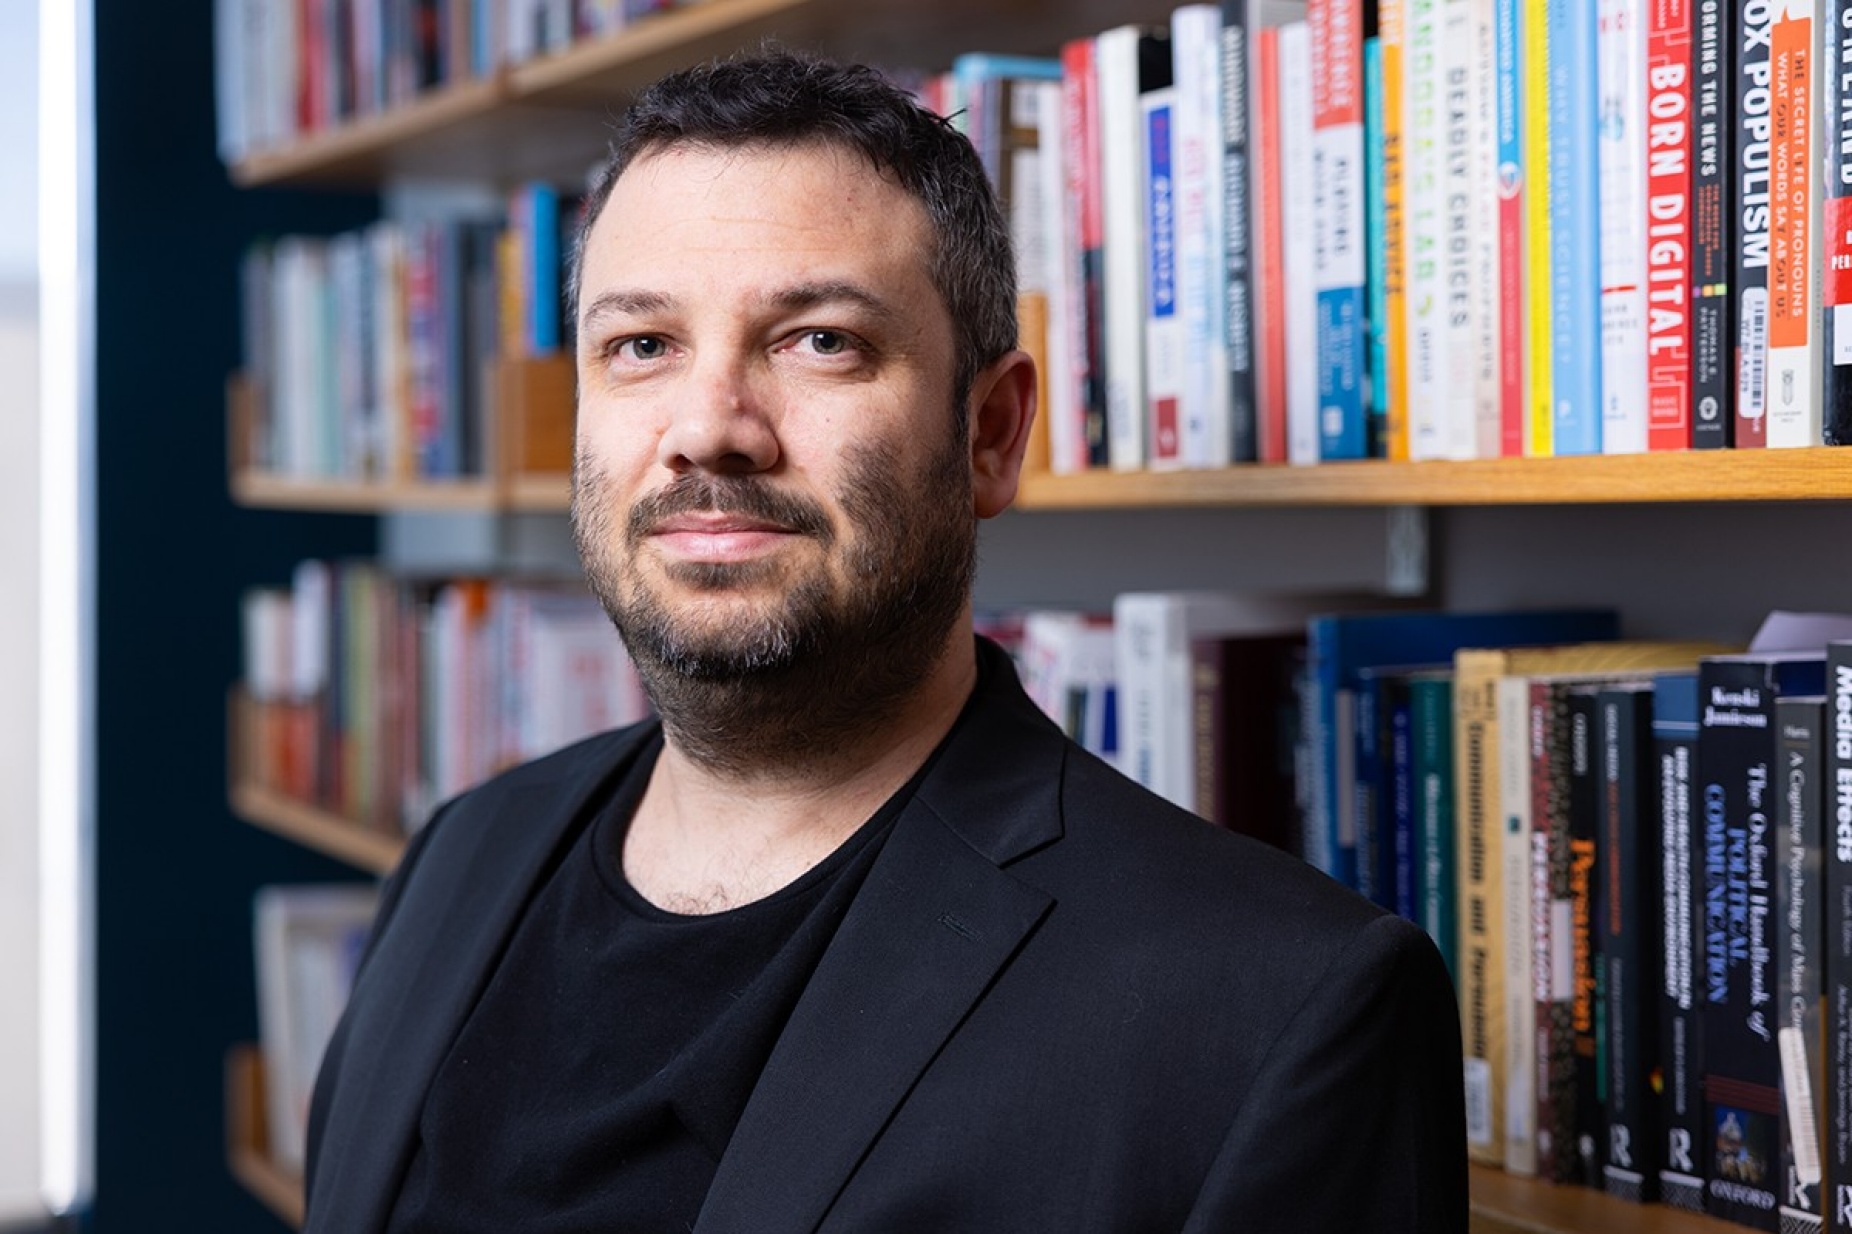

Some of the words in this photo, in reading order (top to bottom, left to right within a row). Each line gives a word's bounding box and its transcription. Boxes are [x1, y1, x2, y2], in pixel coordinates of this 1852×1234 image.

[1777, 52, 1788, 99] WHAT
[1793, 48, 1806, 80] THE
[1446, 66, 1470, 178] DEADLY
[1649, 63, 1687, 177] BORN
[1701, 80, 1717, 117] THE
[1792, 87, 1806, 145] SECRET
[1701, 122, 1717, 177] NEWS
[1743, 60, 1771, 268] POPULISM
[1776, 143, 1788, 202] WORDS
[1792, 152, 1805, 185] LIFE
[1776, 207, 1788, 234] SAY
[1792, 191, 1805, 215] OF
[1447, 192, 1472, 329] CHOICES
[1648, 193, 1686, 356] DIGITAL
[1776, 238, 1788, 292] ABOUT
[1791, 220, 1804, 318] PRONOUNS
[1775, 297, 1786, 319] US
[1836, 665, 1852, 760] Media
[1747, 762, 1768, 808] The
[1790, 751, 1805, 767] A
[1786, 769, 1806, 843] Cognitive
[1836, 767, 1852, 863] Effects
[1748, 812, 1769, 889] Oxford
[1704, 784, 1729, 1003] COMMUNICATION
[1728, 828, 1749, 968] POLITICAL
[1787, 846, 1806, 929] Psychology
[1749, 894, 1771, 1006] Handbook
[1790, 932, 1805, 954] of
[1790, 955, 1806, 994] Mass
[1746, 1011, 1771, 1043] of
[1709, 1179, 1776, 1211] OXFORD
